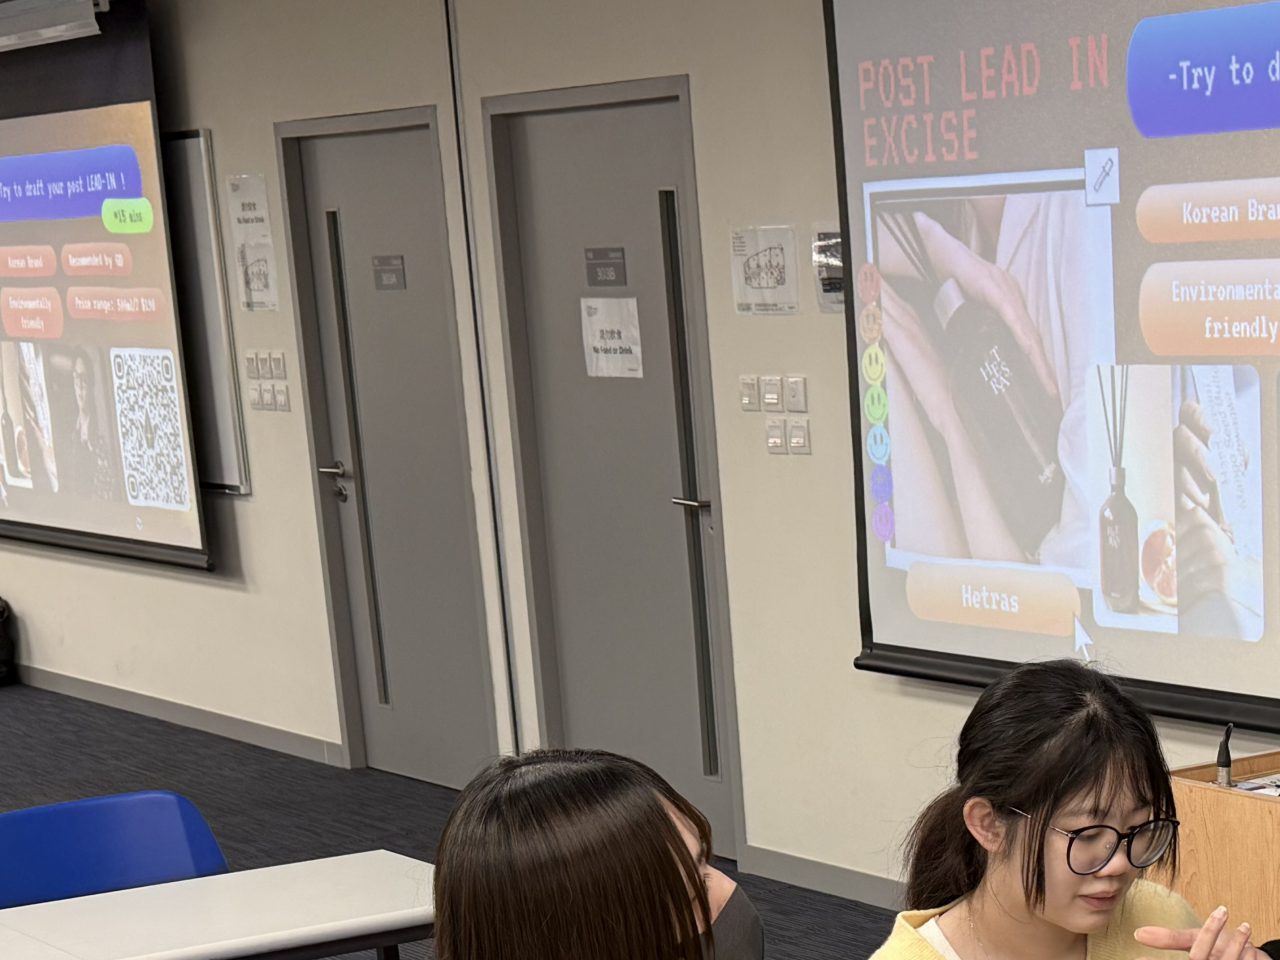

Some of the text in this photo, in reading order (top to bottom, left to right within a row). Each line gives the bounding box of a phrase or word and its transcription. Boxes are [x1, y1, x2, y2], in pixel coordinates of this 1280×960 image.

[858, 32, 1109, 110] POST LEAD IN
[1169, 60, 1216, 96] -Try
[1229, 55, 1254, 85] to
[863, 108, 979, 166] EXCISE
[13, 181, 22, 197] to
[25, 179, 44, 196] draft
[47, 181, 64, 199] your
[67, 176, 84, 198] post
[1183, 201, 1239, 224] Korean
[1204, 315, 1278, 343] friendly
[961, 584, 1019, 613] Hetras
